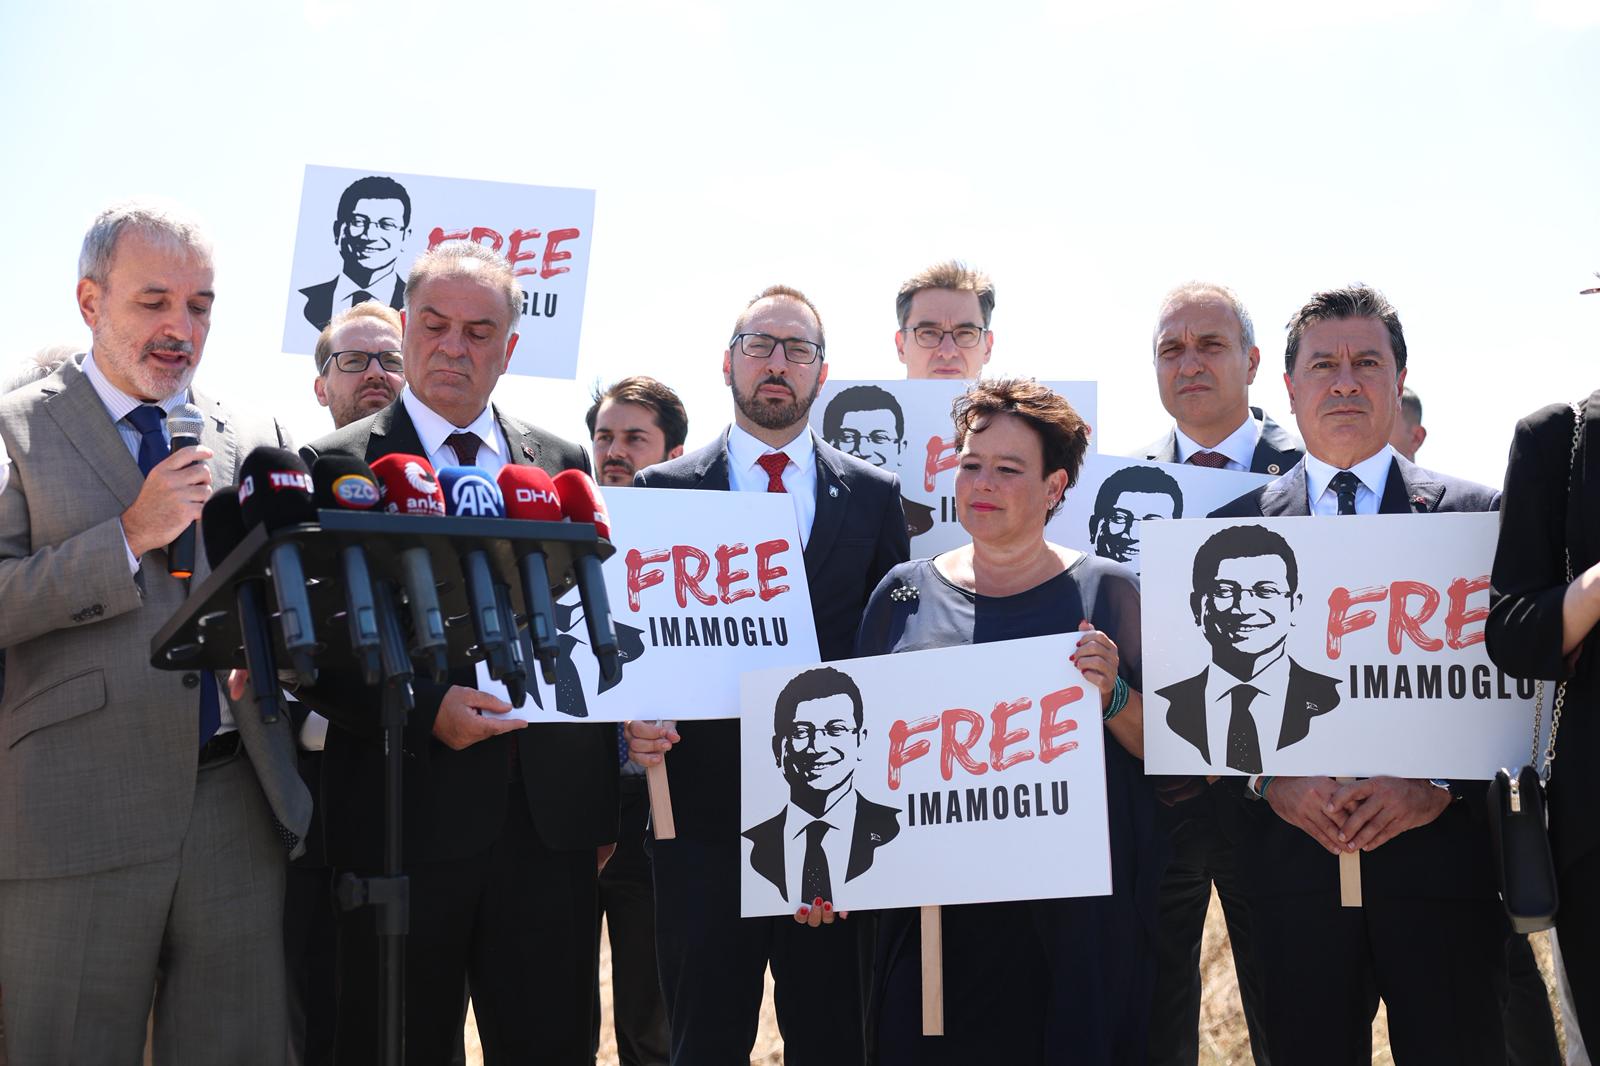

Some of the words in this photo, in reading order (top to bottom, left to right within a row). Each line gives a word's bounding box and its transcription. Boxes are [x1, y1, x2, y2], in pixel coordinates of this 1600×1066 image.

[455, 485, 501, 517] AA
[624, 538, 791, 613] FREE
[648, 616, 789, 647] IMAMOGLU
[1325, 574, 1491, 660] FRE
[887, 685, 1085, 791] FREE
[907, 780, 1070, 827] IMAMOGLU
